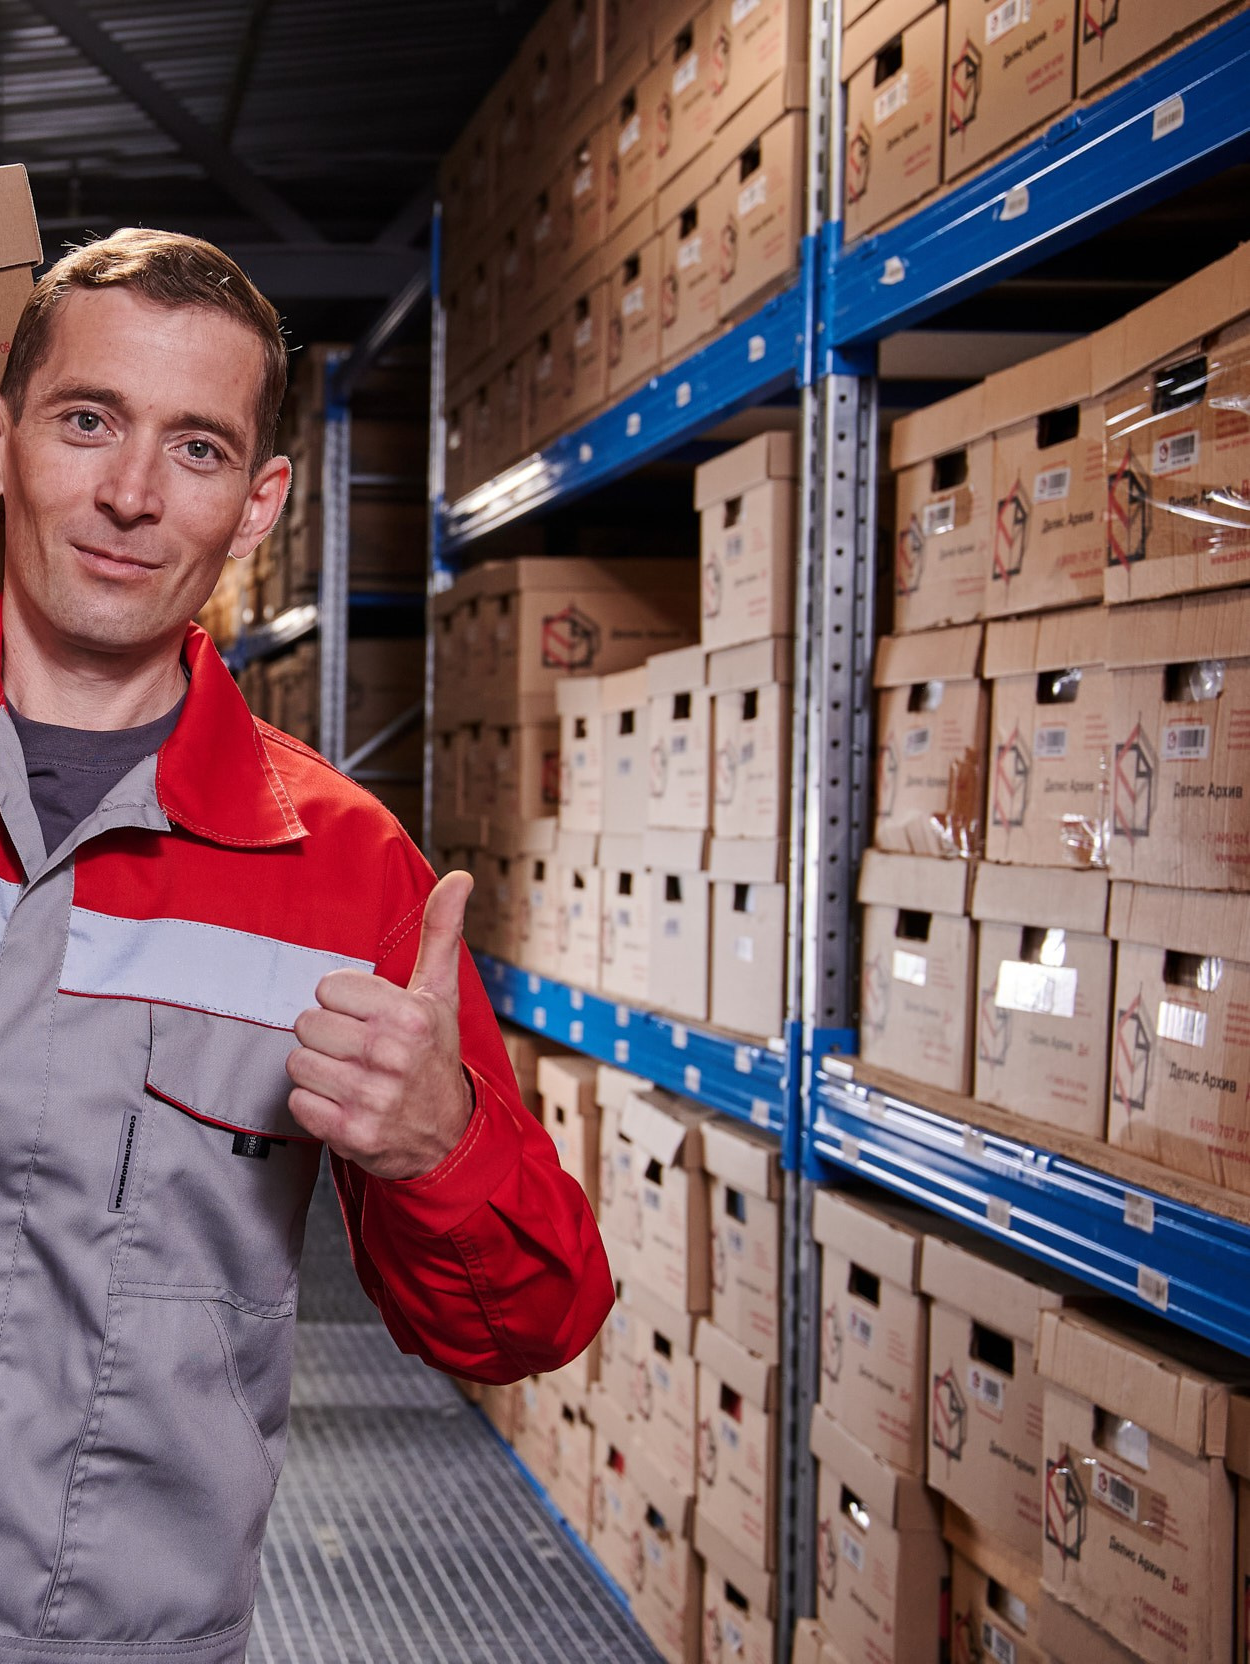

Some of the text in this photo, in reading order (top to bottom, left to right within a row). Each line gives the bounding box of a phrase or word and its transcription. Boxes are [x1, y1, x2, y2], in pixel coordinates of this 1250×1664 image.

[1174, 781, 1243, 801] Делис Архив
[1169, 1061, 1237, 1093] Делис Архив
[115, 1115, 137, 1209] СОЮЗСПЕЦОДЕЖДА
